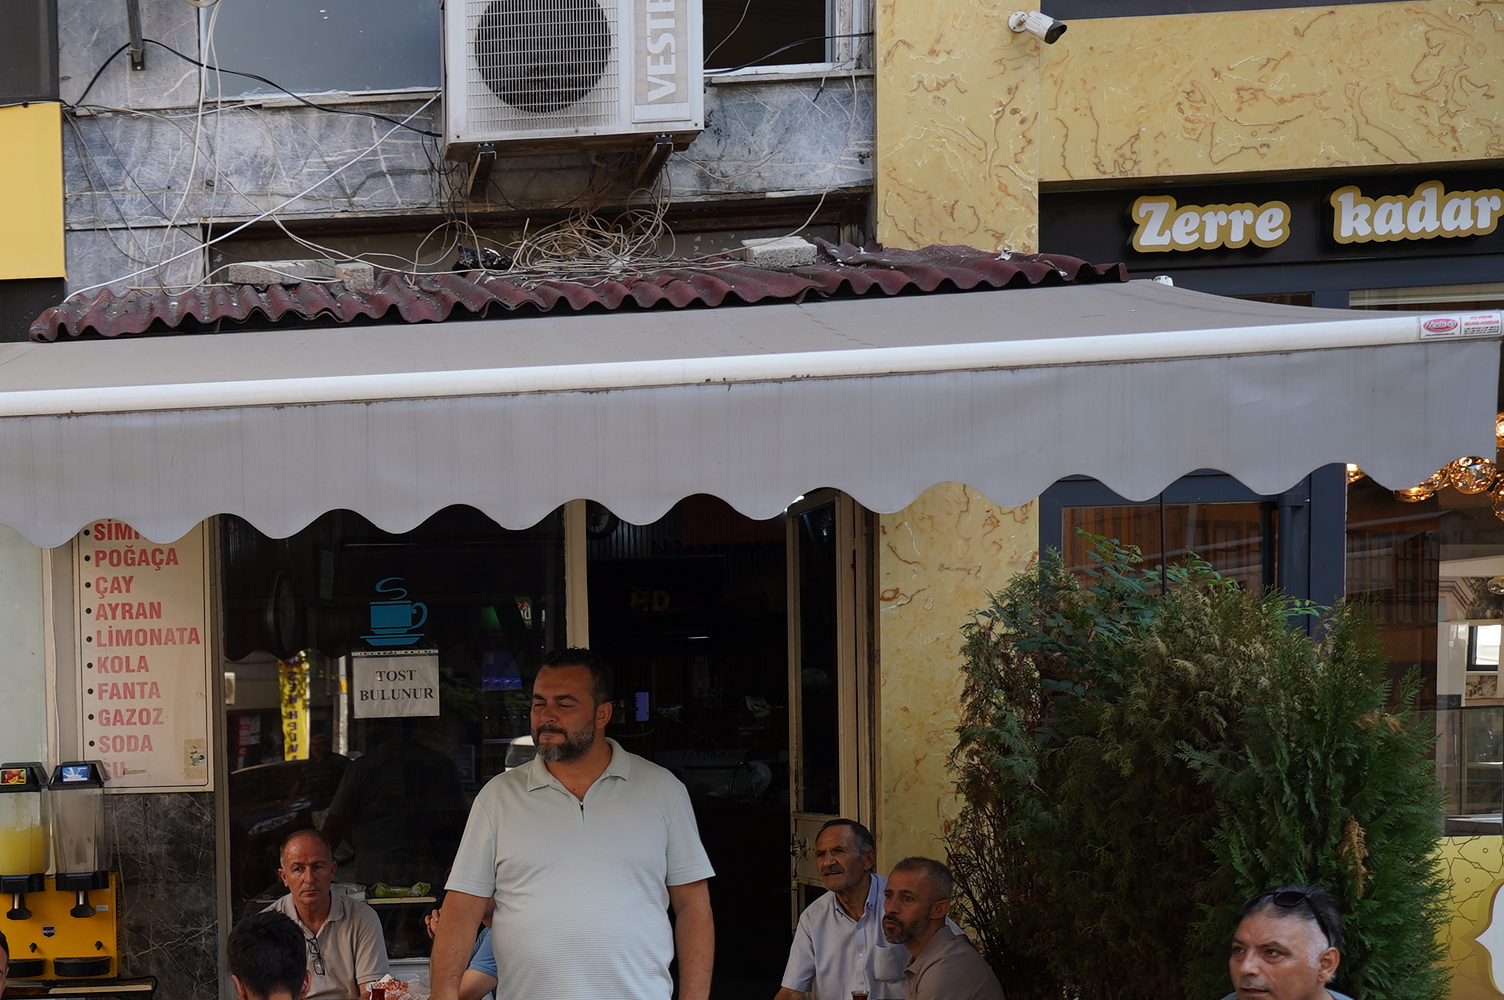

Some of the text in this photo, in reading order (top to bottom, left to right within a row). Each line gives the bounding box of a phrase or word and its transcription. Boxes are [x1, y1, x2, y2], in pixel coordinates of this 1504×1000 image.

[1136, 186, 1502, 248] Zerre kadar
[93, 519, 147, 541] SİM
[95, 545, 179, 571] POĞAÇA
[95, 575, 134, 599] ÇAY
[95, 602, 162, 621] AYRAN
[96, 625, 201, 647] LİMONATA
[97, 655, 150, 674] KOLA
[375, 669, 417, 682] TOST
[97, 681, 161, 700] FANTA
[359, 687, 435, 702] BULUNUR
[98, 707, 164, 727] GAZOZ
[98, 734, 154, 753] SODA
